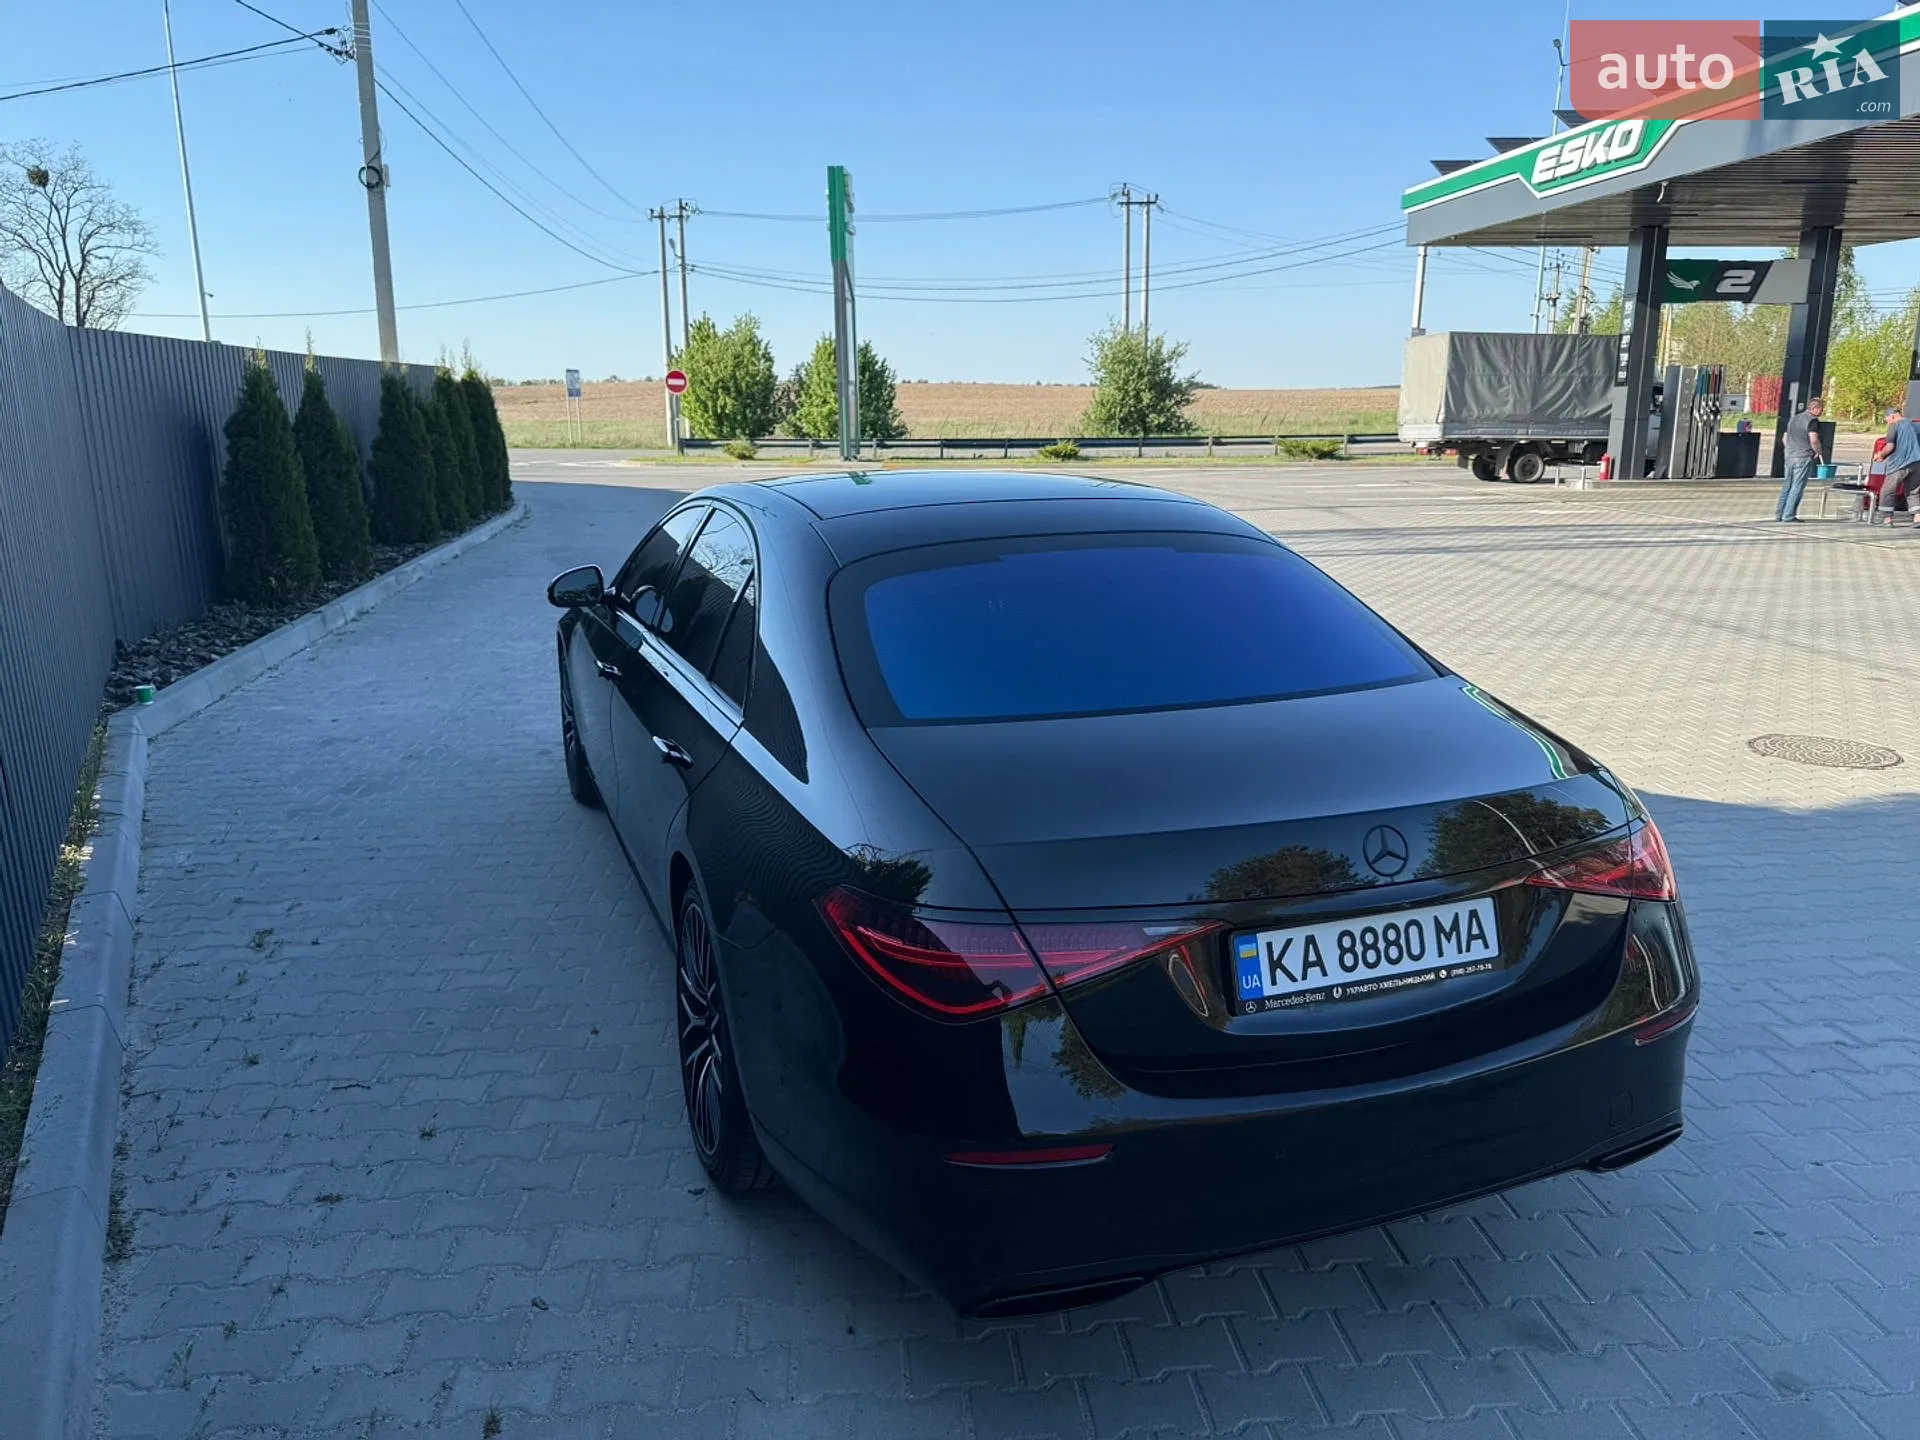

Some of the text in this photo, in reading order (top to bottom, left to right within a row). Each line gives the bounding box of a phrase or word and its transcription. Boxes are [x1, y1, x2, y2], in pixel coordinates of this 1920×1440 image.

[1531, 118, 1648, 185] ESKO
[1715, 269, 1756, 294] 2
[1265, 908, 1490, 986] KA 8880 MA
[1242, 974, 1261, 989] UA
[1346, 981, 1378, 996] УКРАВТО
[1264, 991, 1326, 1010] Mercedes-Benz
